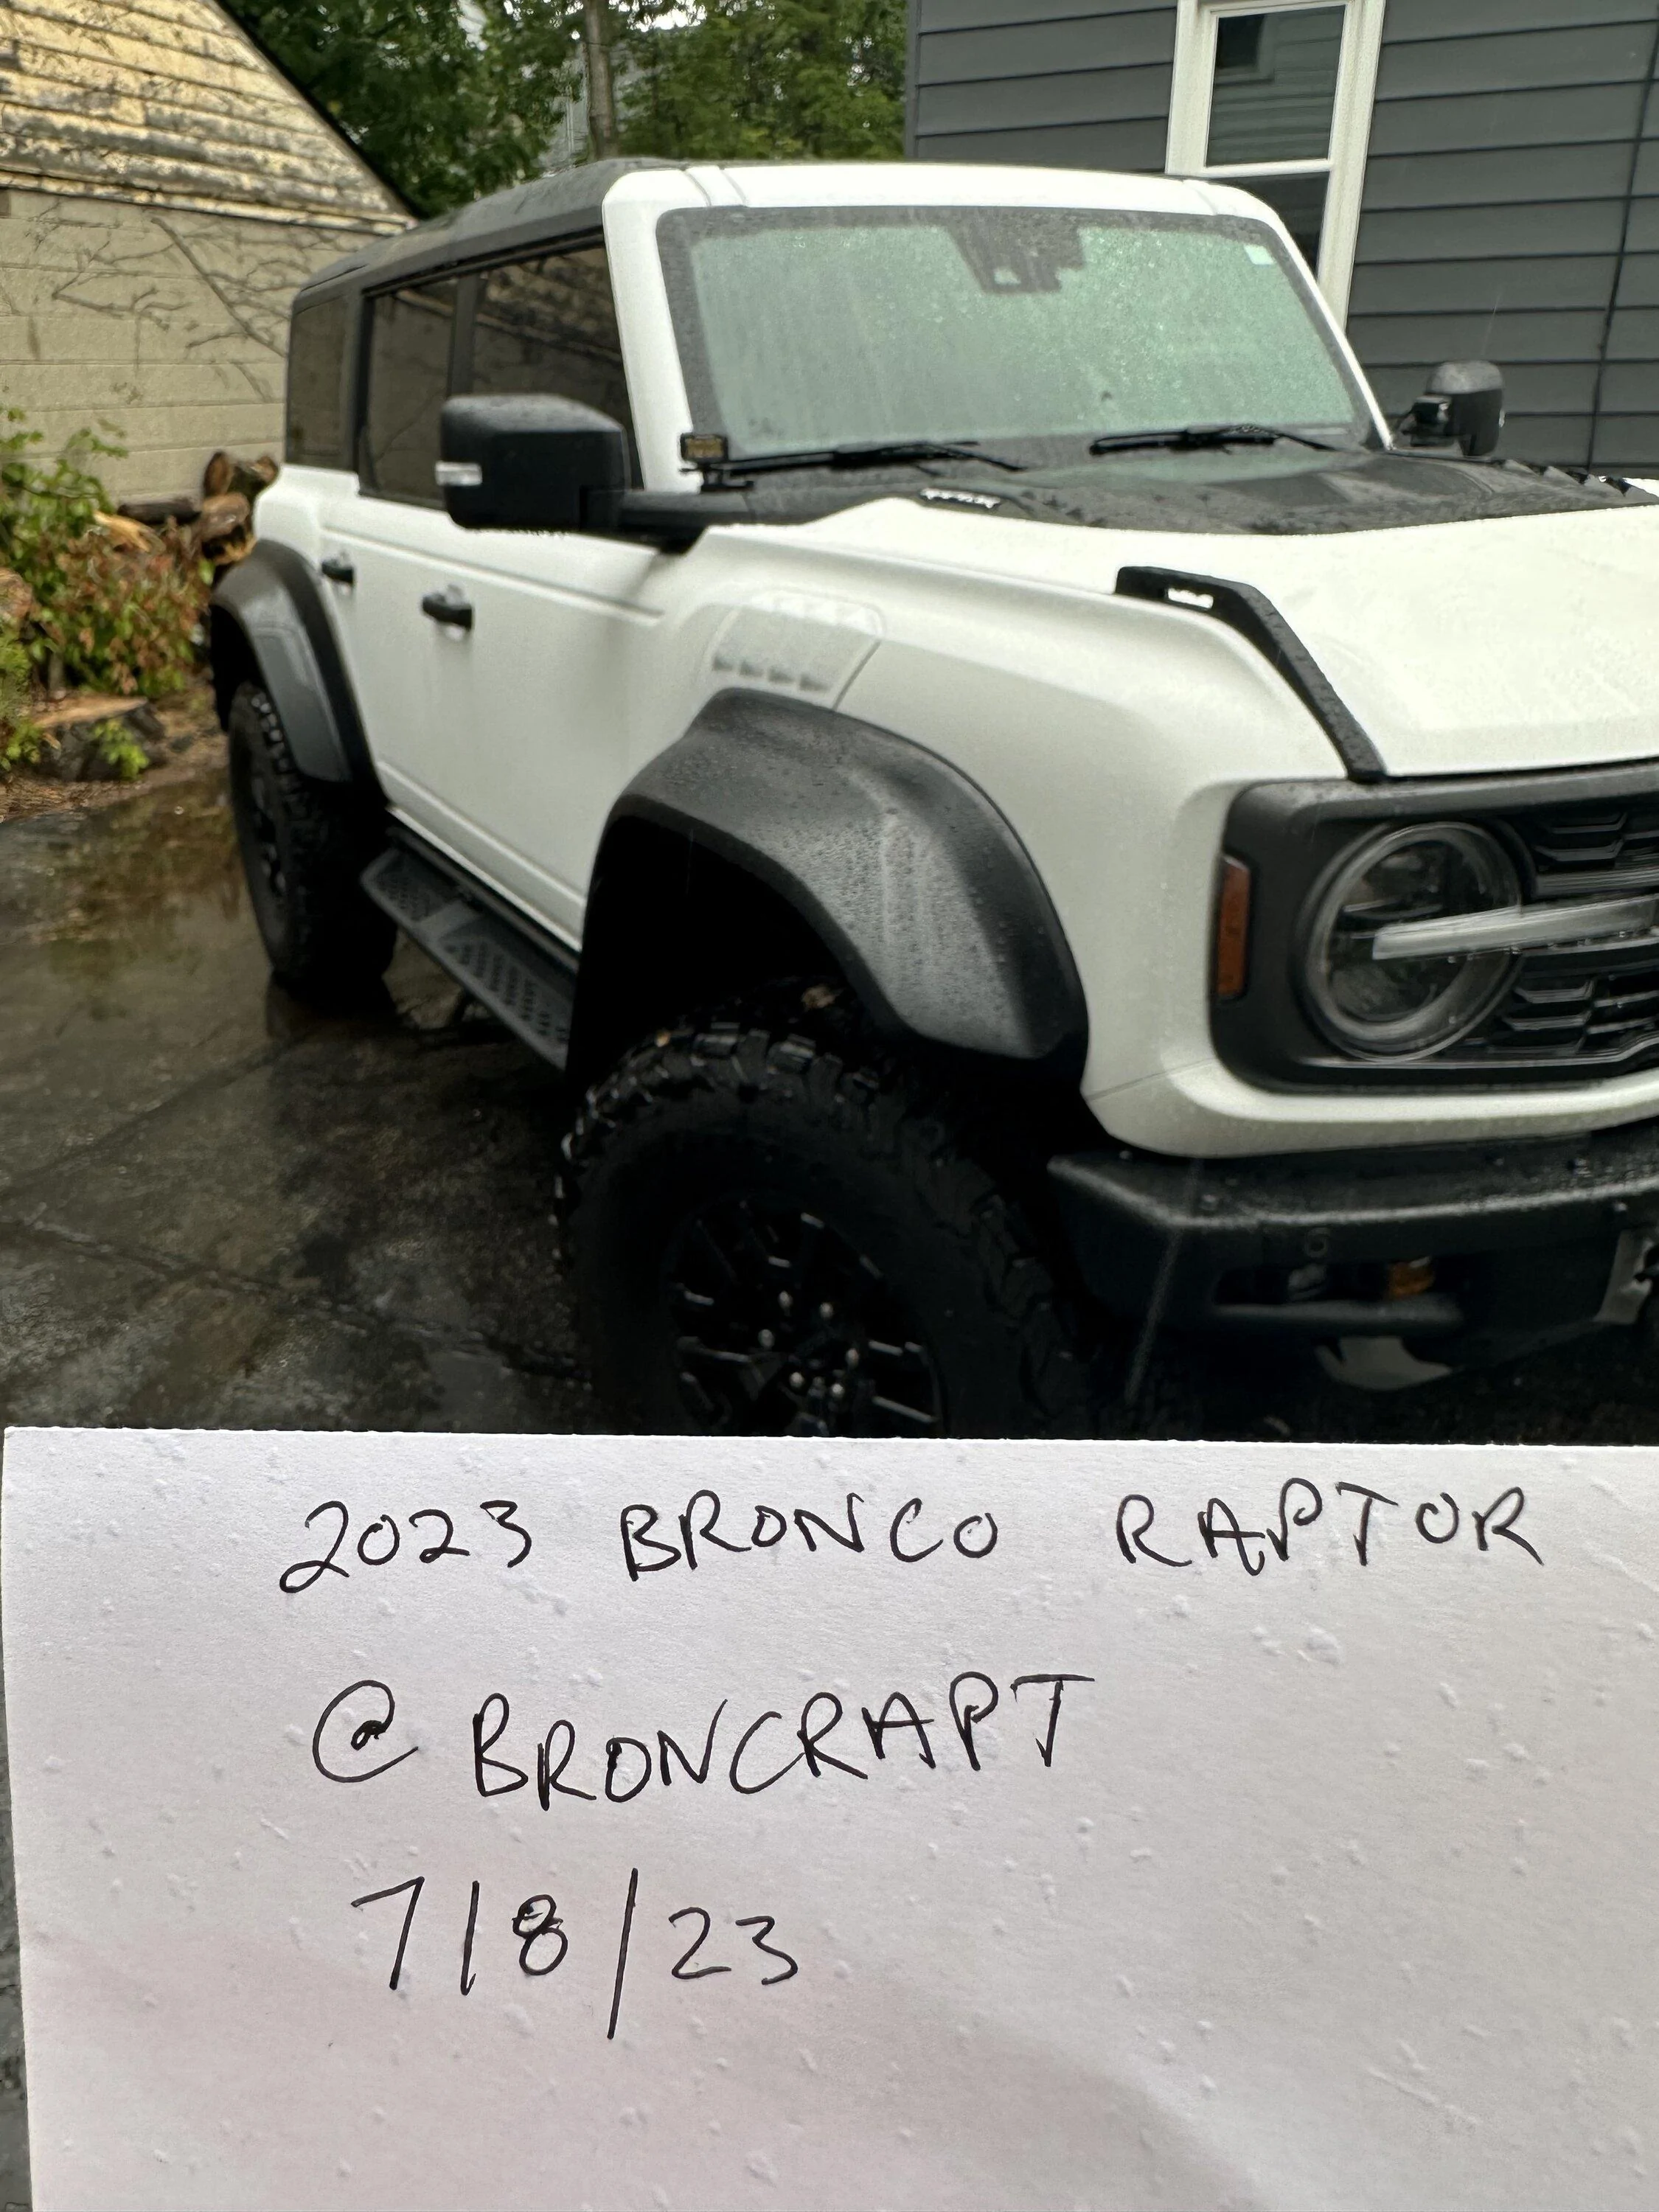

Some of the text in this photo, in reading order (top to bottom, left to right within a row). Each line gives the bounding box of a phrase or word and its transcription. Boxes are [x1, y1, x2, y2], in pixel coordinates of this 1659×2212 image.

[279, 1477, 1544, 1596] 2023 BRONCO RAPTOR
[350, 1867, 798, 2040] 7/8/23
